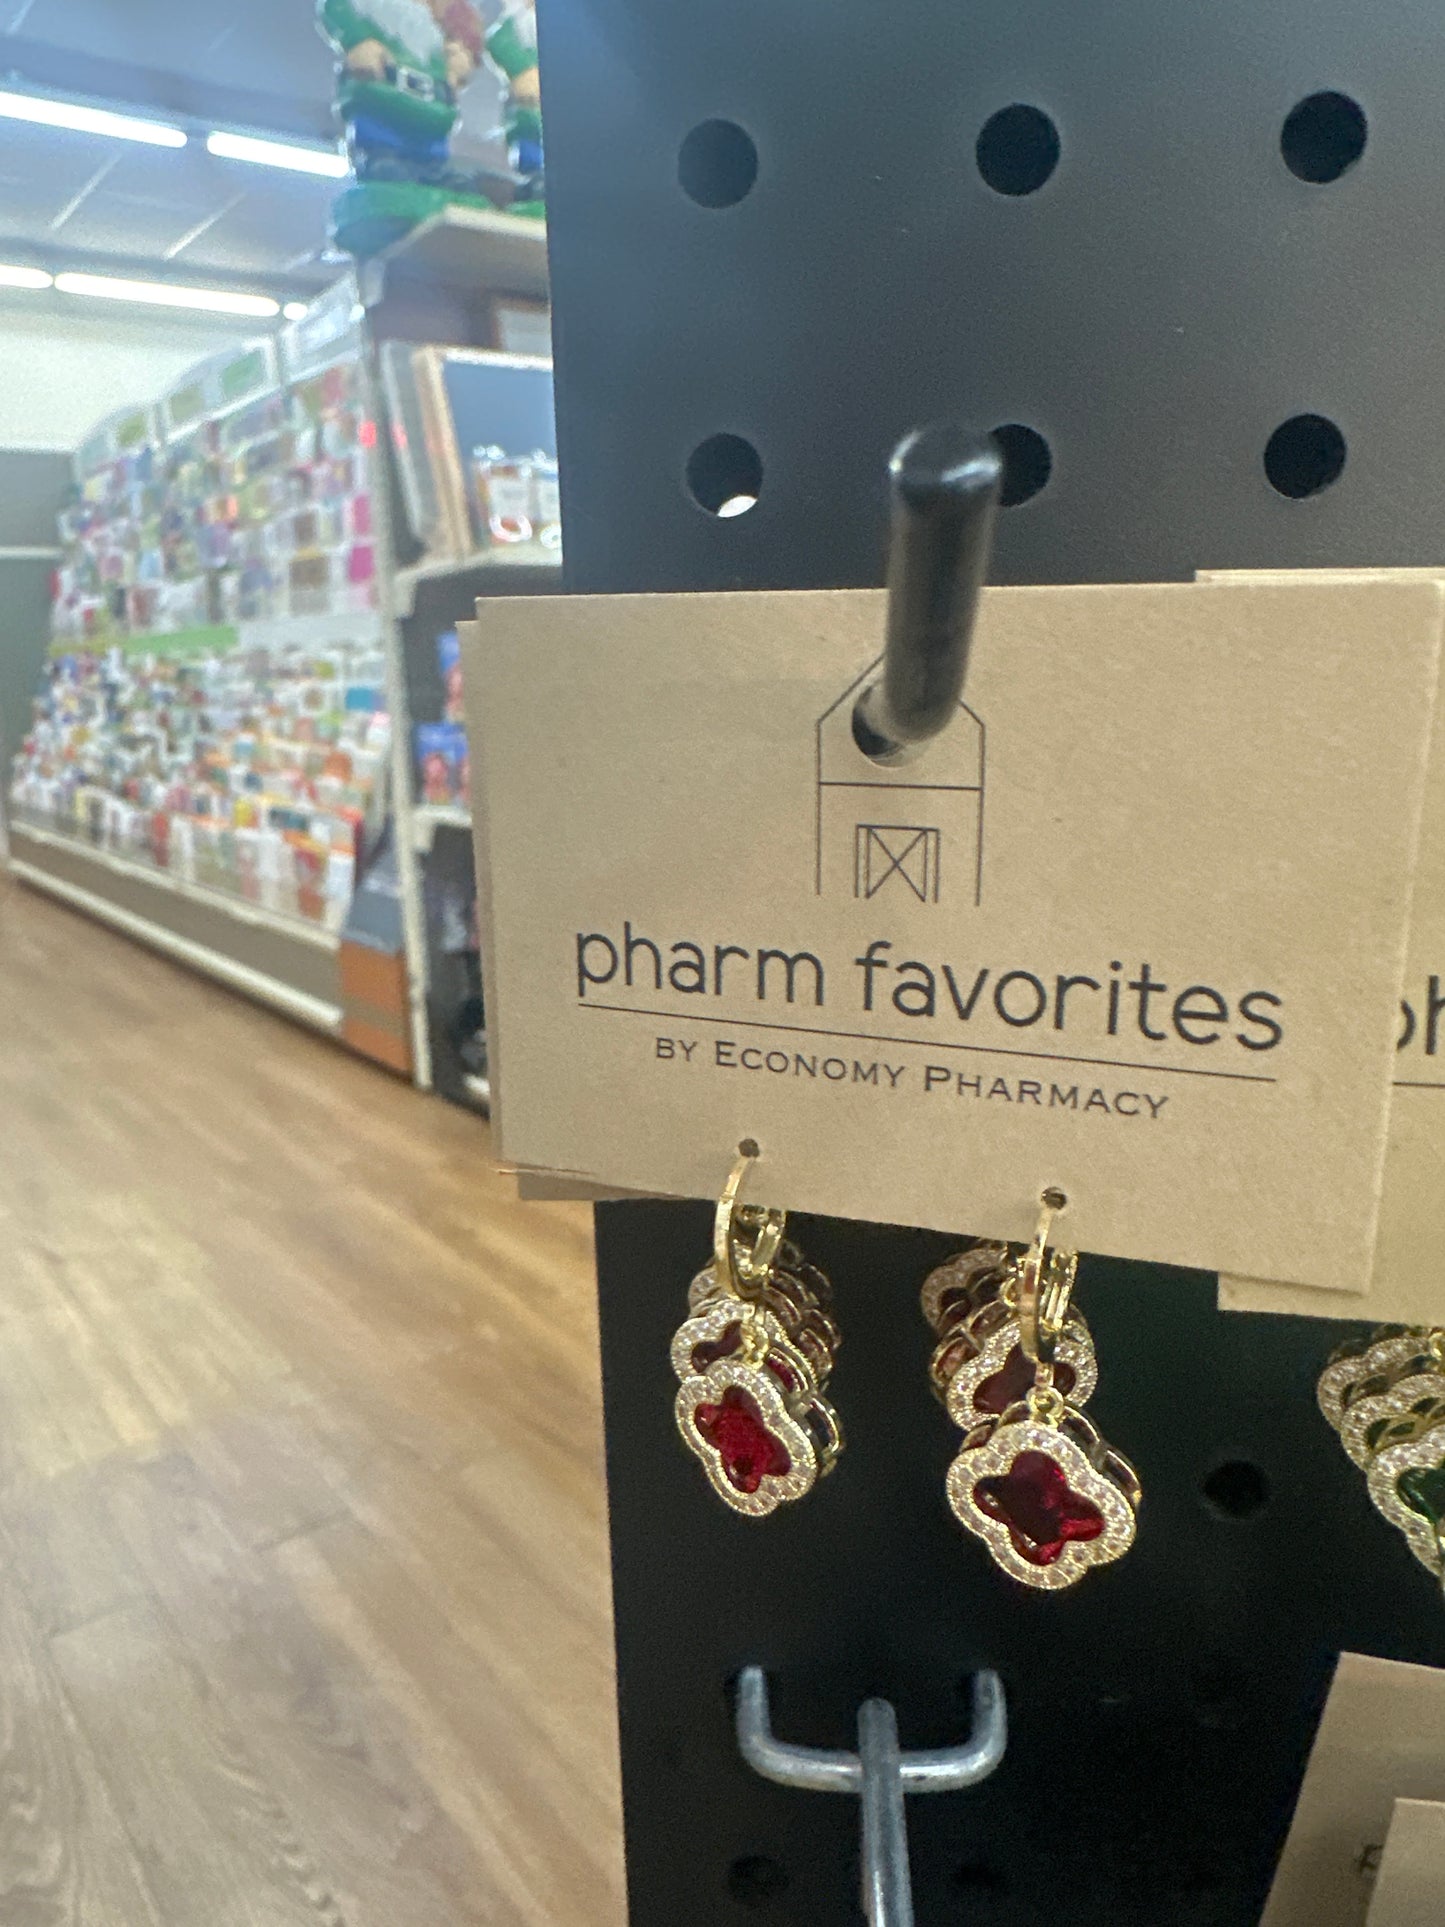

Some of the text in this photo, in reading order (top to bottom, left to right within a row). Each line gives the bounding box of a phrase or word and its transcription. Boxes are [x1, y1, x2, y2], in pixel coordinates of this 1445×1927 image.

[576, 919, 825, 1007] pharm
[855, 940, 1284, 1052] favorites
[655, 1036, 1169, 1119] BY ECONOMY PHARMACY
